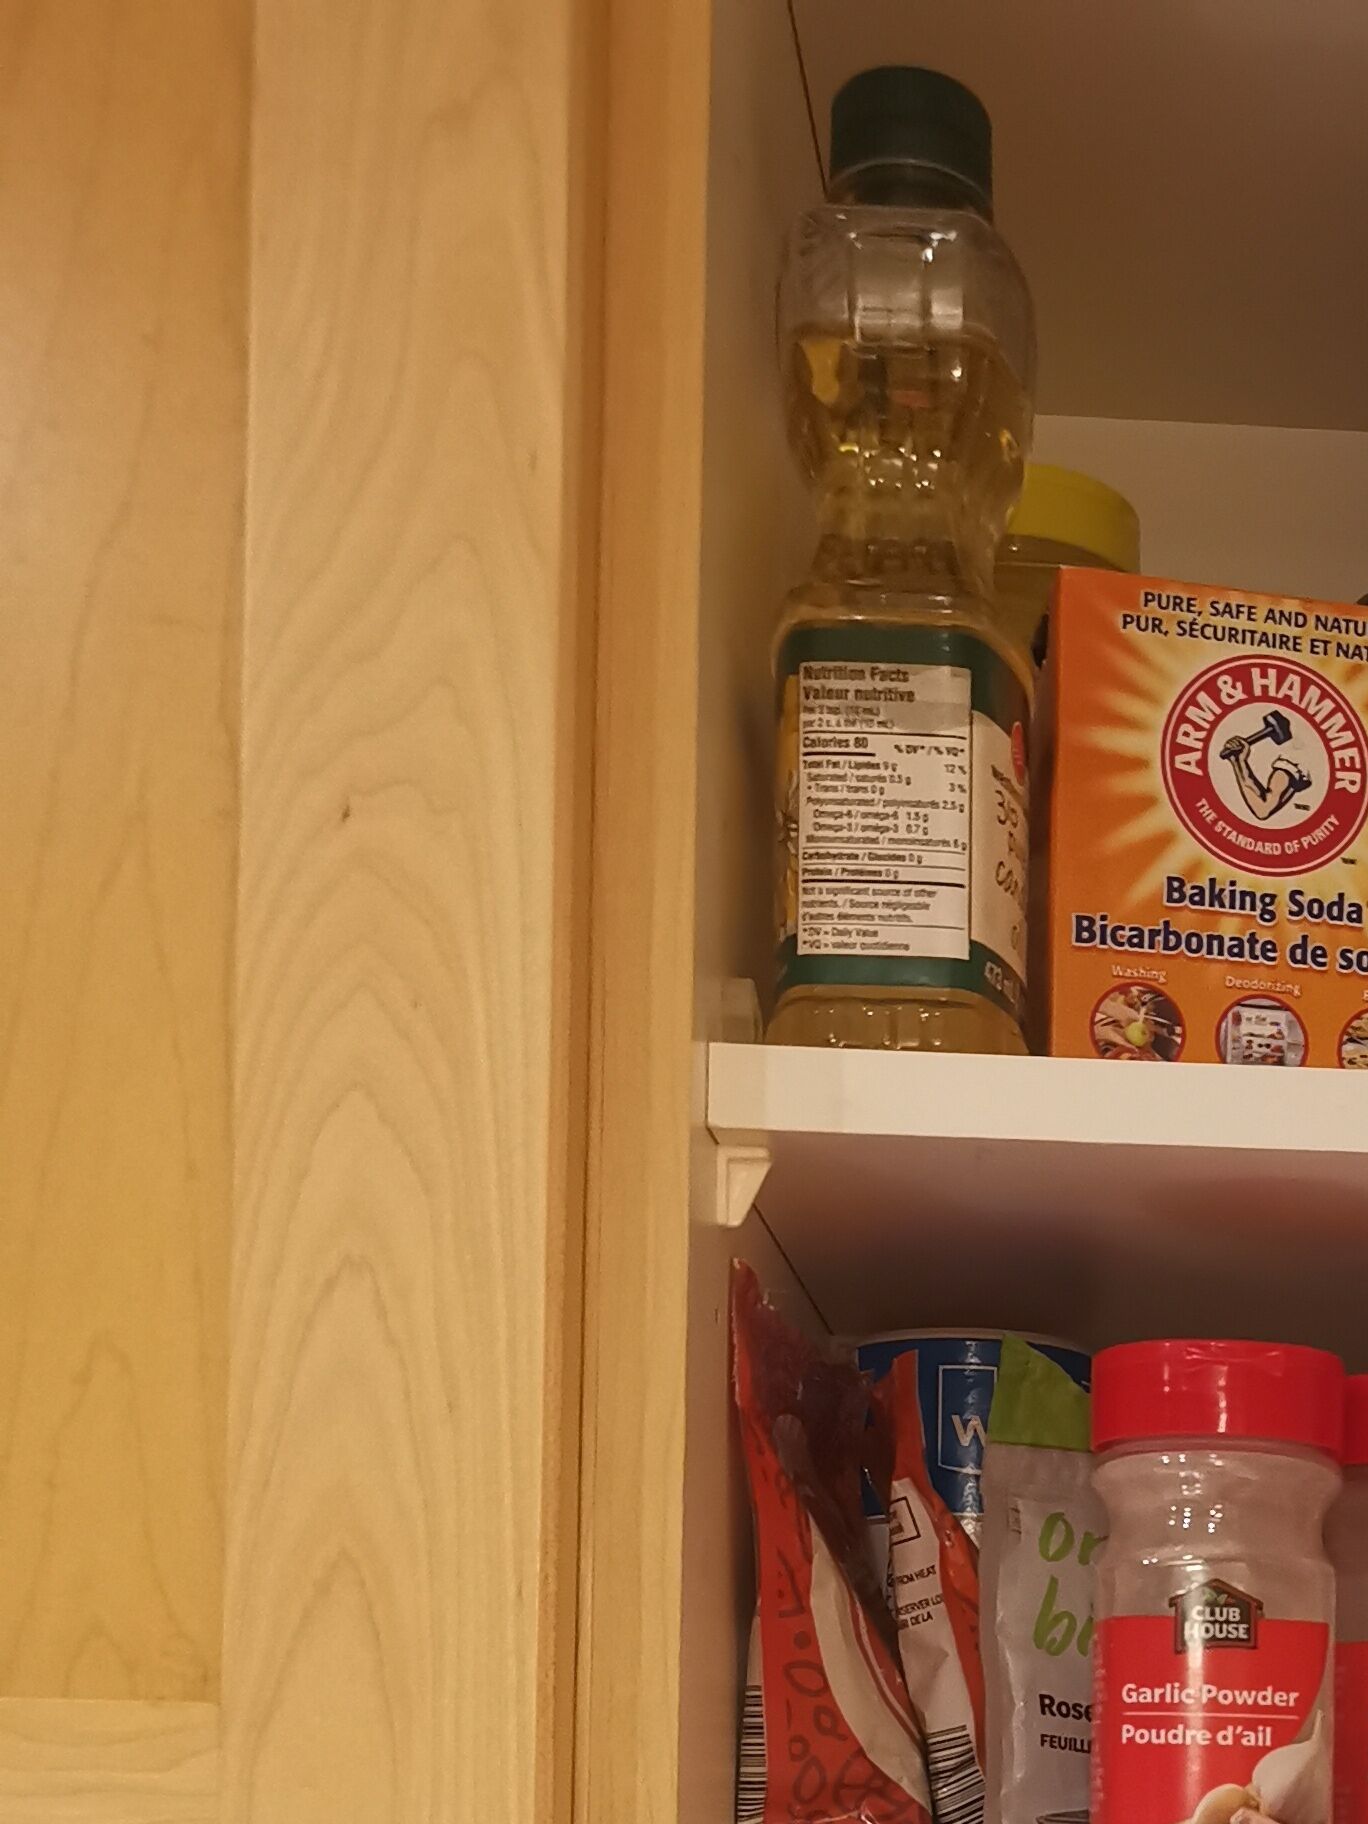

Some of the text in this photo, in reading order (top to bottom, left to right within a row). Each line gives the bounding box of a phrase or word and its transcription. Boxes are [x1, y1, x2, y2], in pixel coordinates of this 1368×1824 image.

[1144, 592, 1203, 618] PURE,
[1209, 600, 1257, 622] SAFE
[1265, 607, 1308, 628] AND
[1121, 614, 1169, 636] PUR,
[1176, 617, 1303, 652] SÉCURITAIRE
[1309, 636, 1333, 656] ET
[803, 737, 868, 748] Calories 80
[1174, 668, 1362, 794] ARM & HAMMER
[1196, 798, 1340, 855] THE STANDARD OF PURITY
[1165, 876, 1364, 925] Baking Soda
[1073, 914, 1278, 963] Bicarbonate
[1289, 932, 1329, 969] de
[1112, 966, 1167, 983] Washing
[1224, 976, 1301, 996] Deodorizing
[1192, 1605, 1241, 1622] CLUB
[1184, 1624, 1250, 1639] HOUSE
[1121, 1683, 1299, 1707] Garlic Powder
[1121, 1724, 1212, 1745] Poudre
